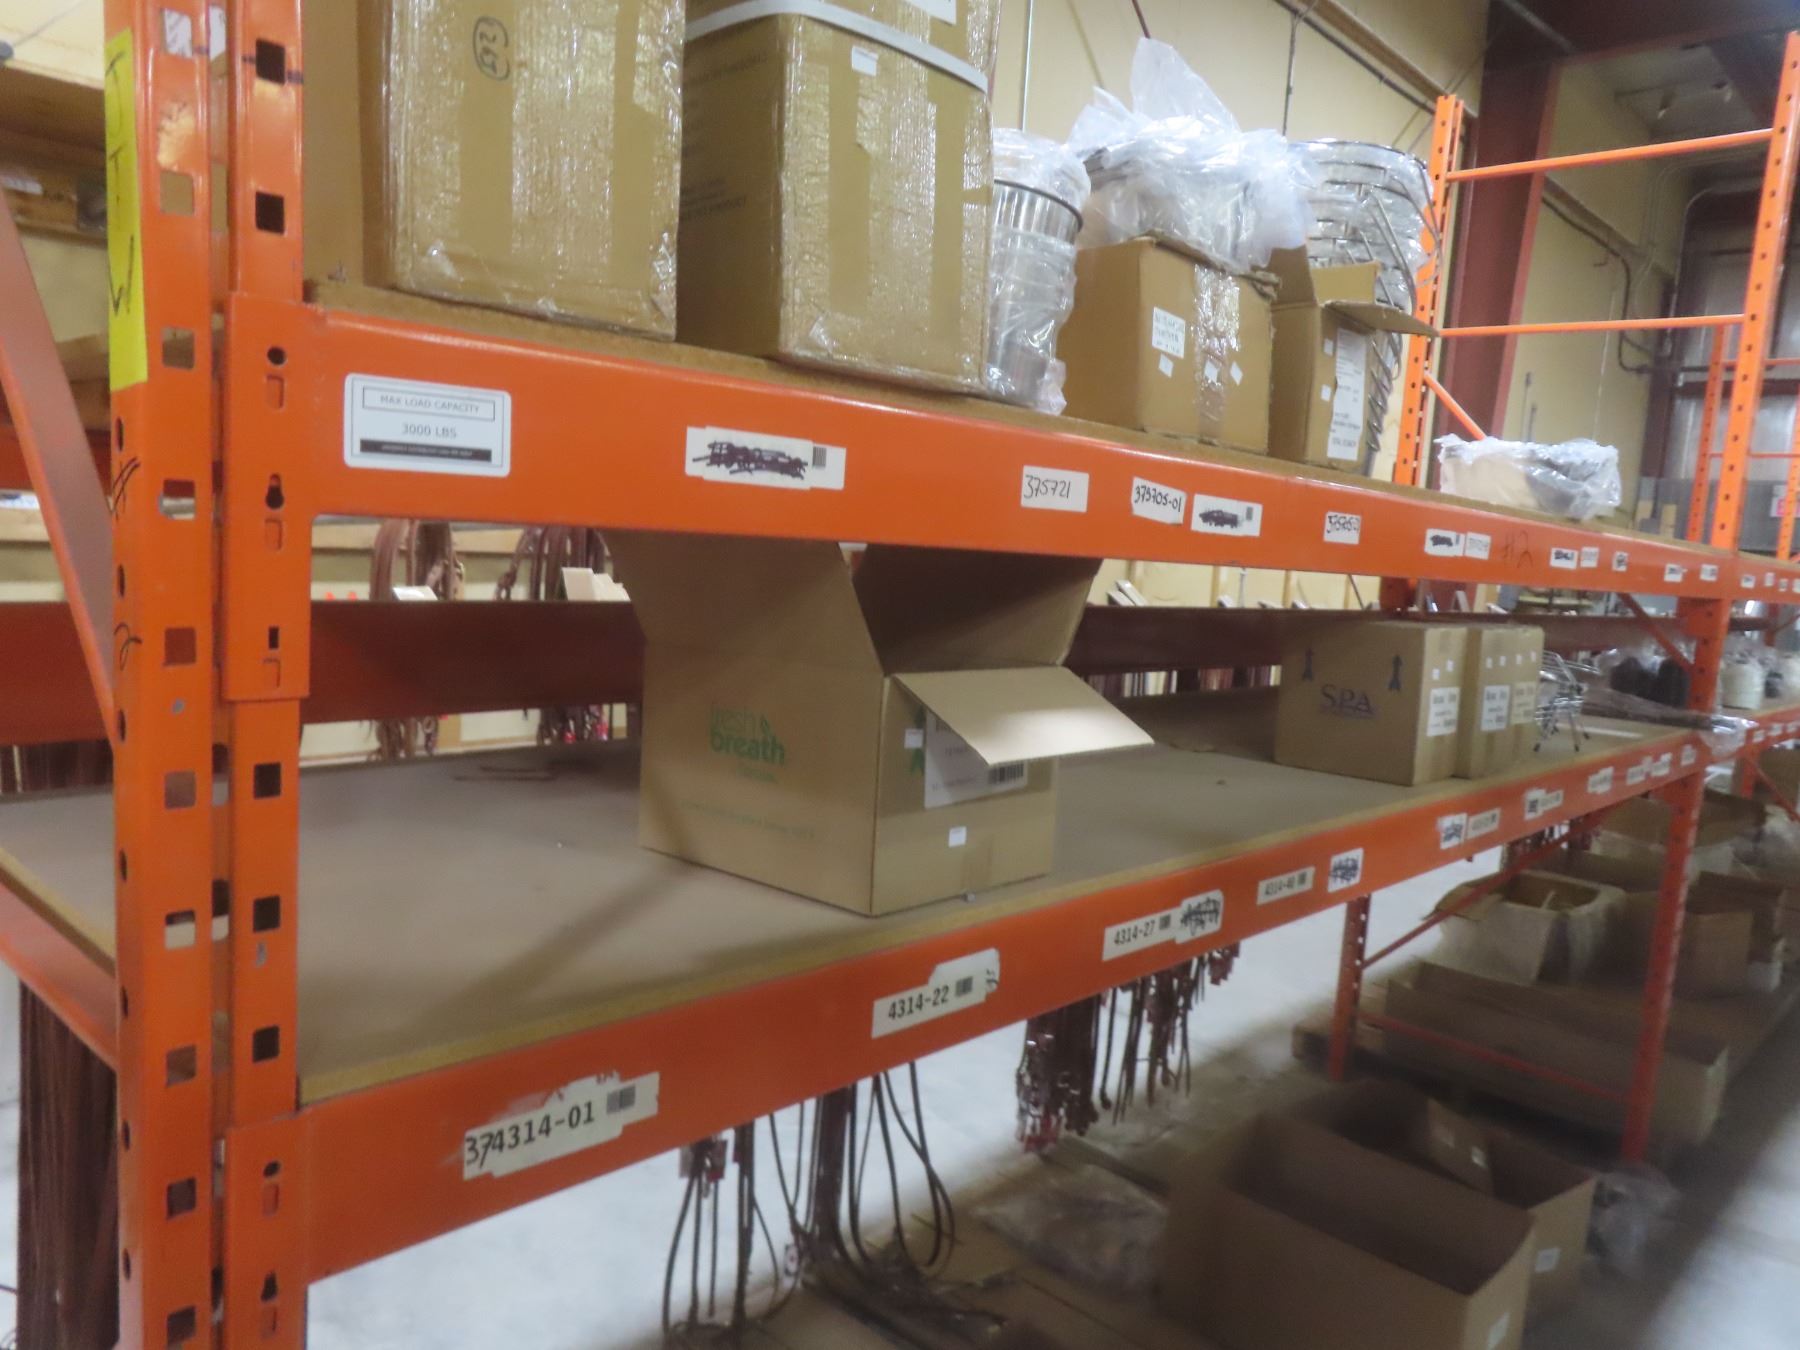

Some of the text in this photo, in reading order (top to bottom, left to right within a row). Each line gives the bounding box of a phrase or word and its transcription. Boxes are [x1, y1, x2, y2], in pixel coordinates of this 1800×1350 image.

[380, 394, 480, 415] MAX LOAD CAPACITY
[402, 423, 457, 439] 3000 LBS
[1023, 474, 1072, 500] 375721
[710, 727, 786, 768] breath
[1113, 918, 1156, 946] 4314-27
[888, 984, 950, 1020] 4314-22
[464, 1101, 596, 1169] 374314-01
